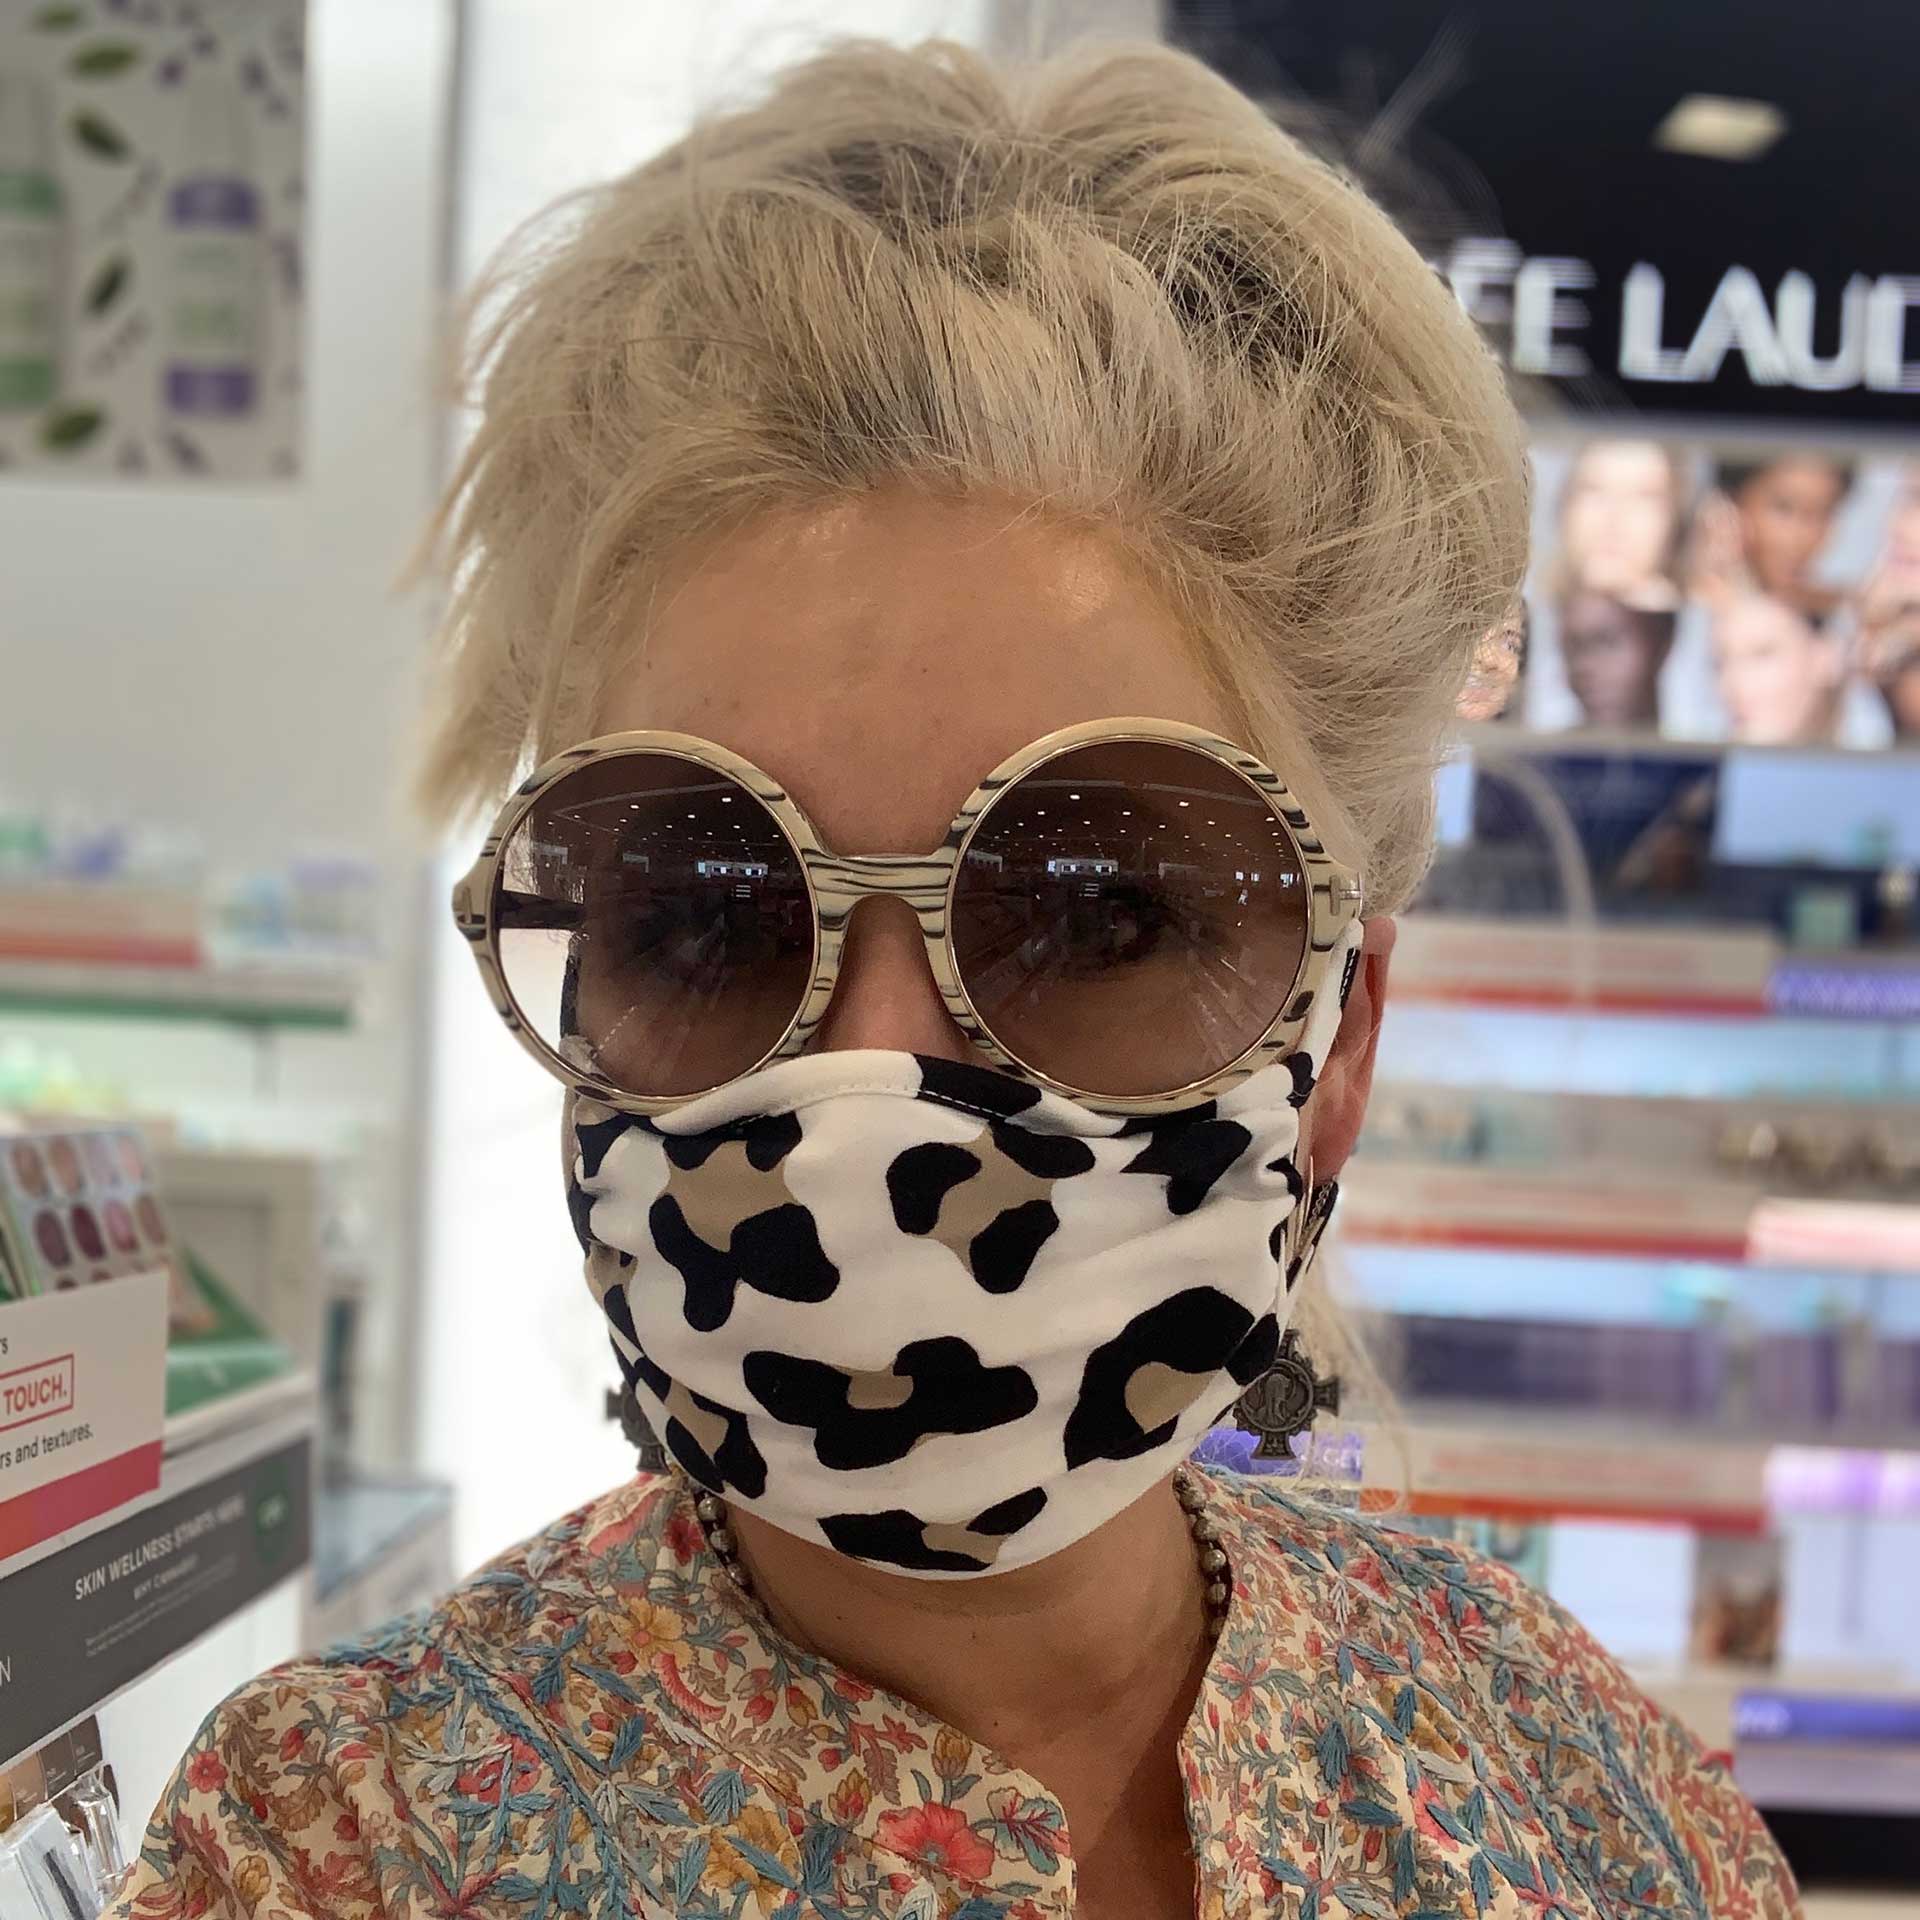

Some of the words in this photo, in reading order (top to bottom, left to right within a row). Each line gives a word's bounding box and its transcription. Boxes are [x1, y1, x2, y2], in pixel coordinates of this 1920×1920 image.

[3, 1373, 67, 1416] TOUCH.
[15, 1435, 38, 1463] and
[42, 1423, 93, 1454] textures.
[75, 1565, 106, 1601] SKIN
[107, 1532, 173, 1583] WELLNESS
